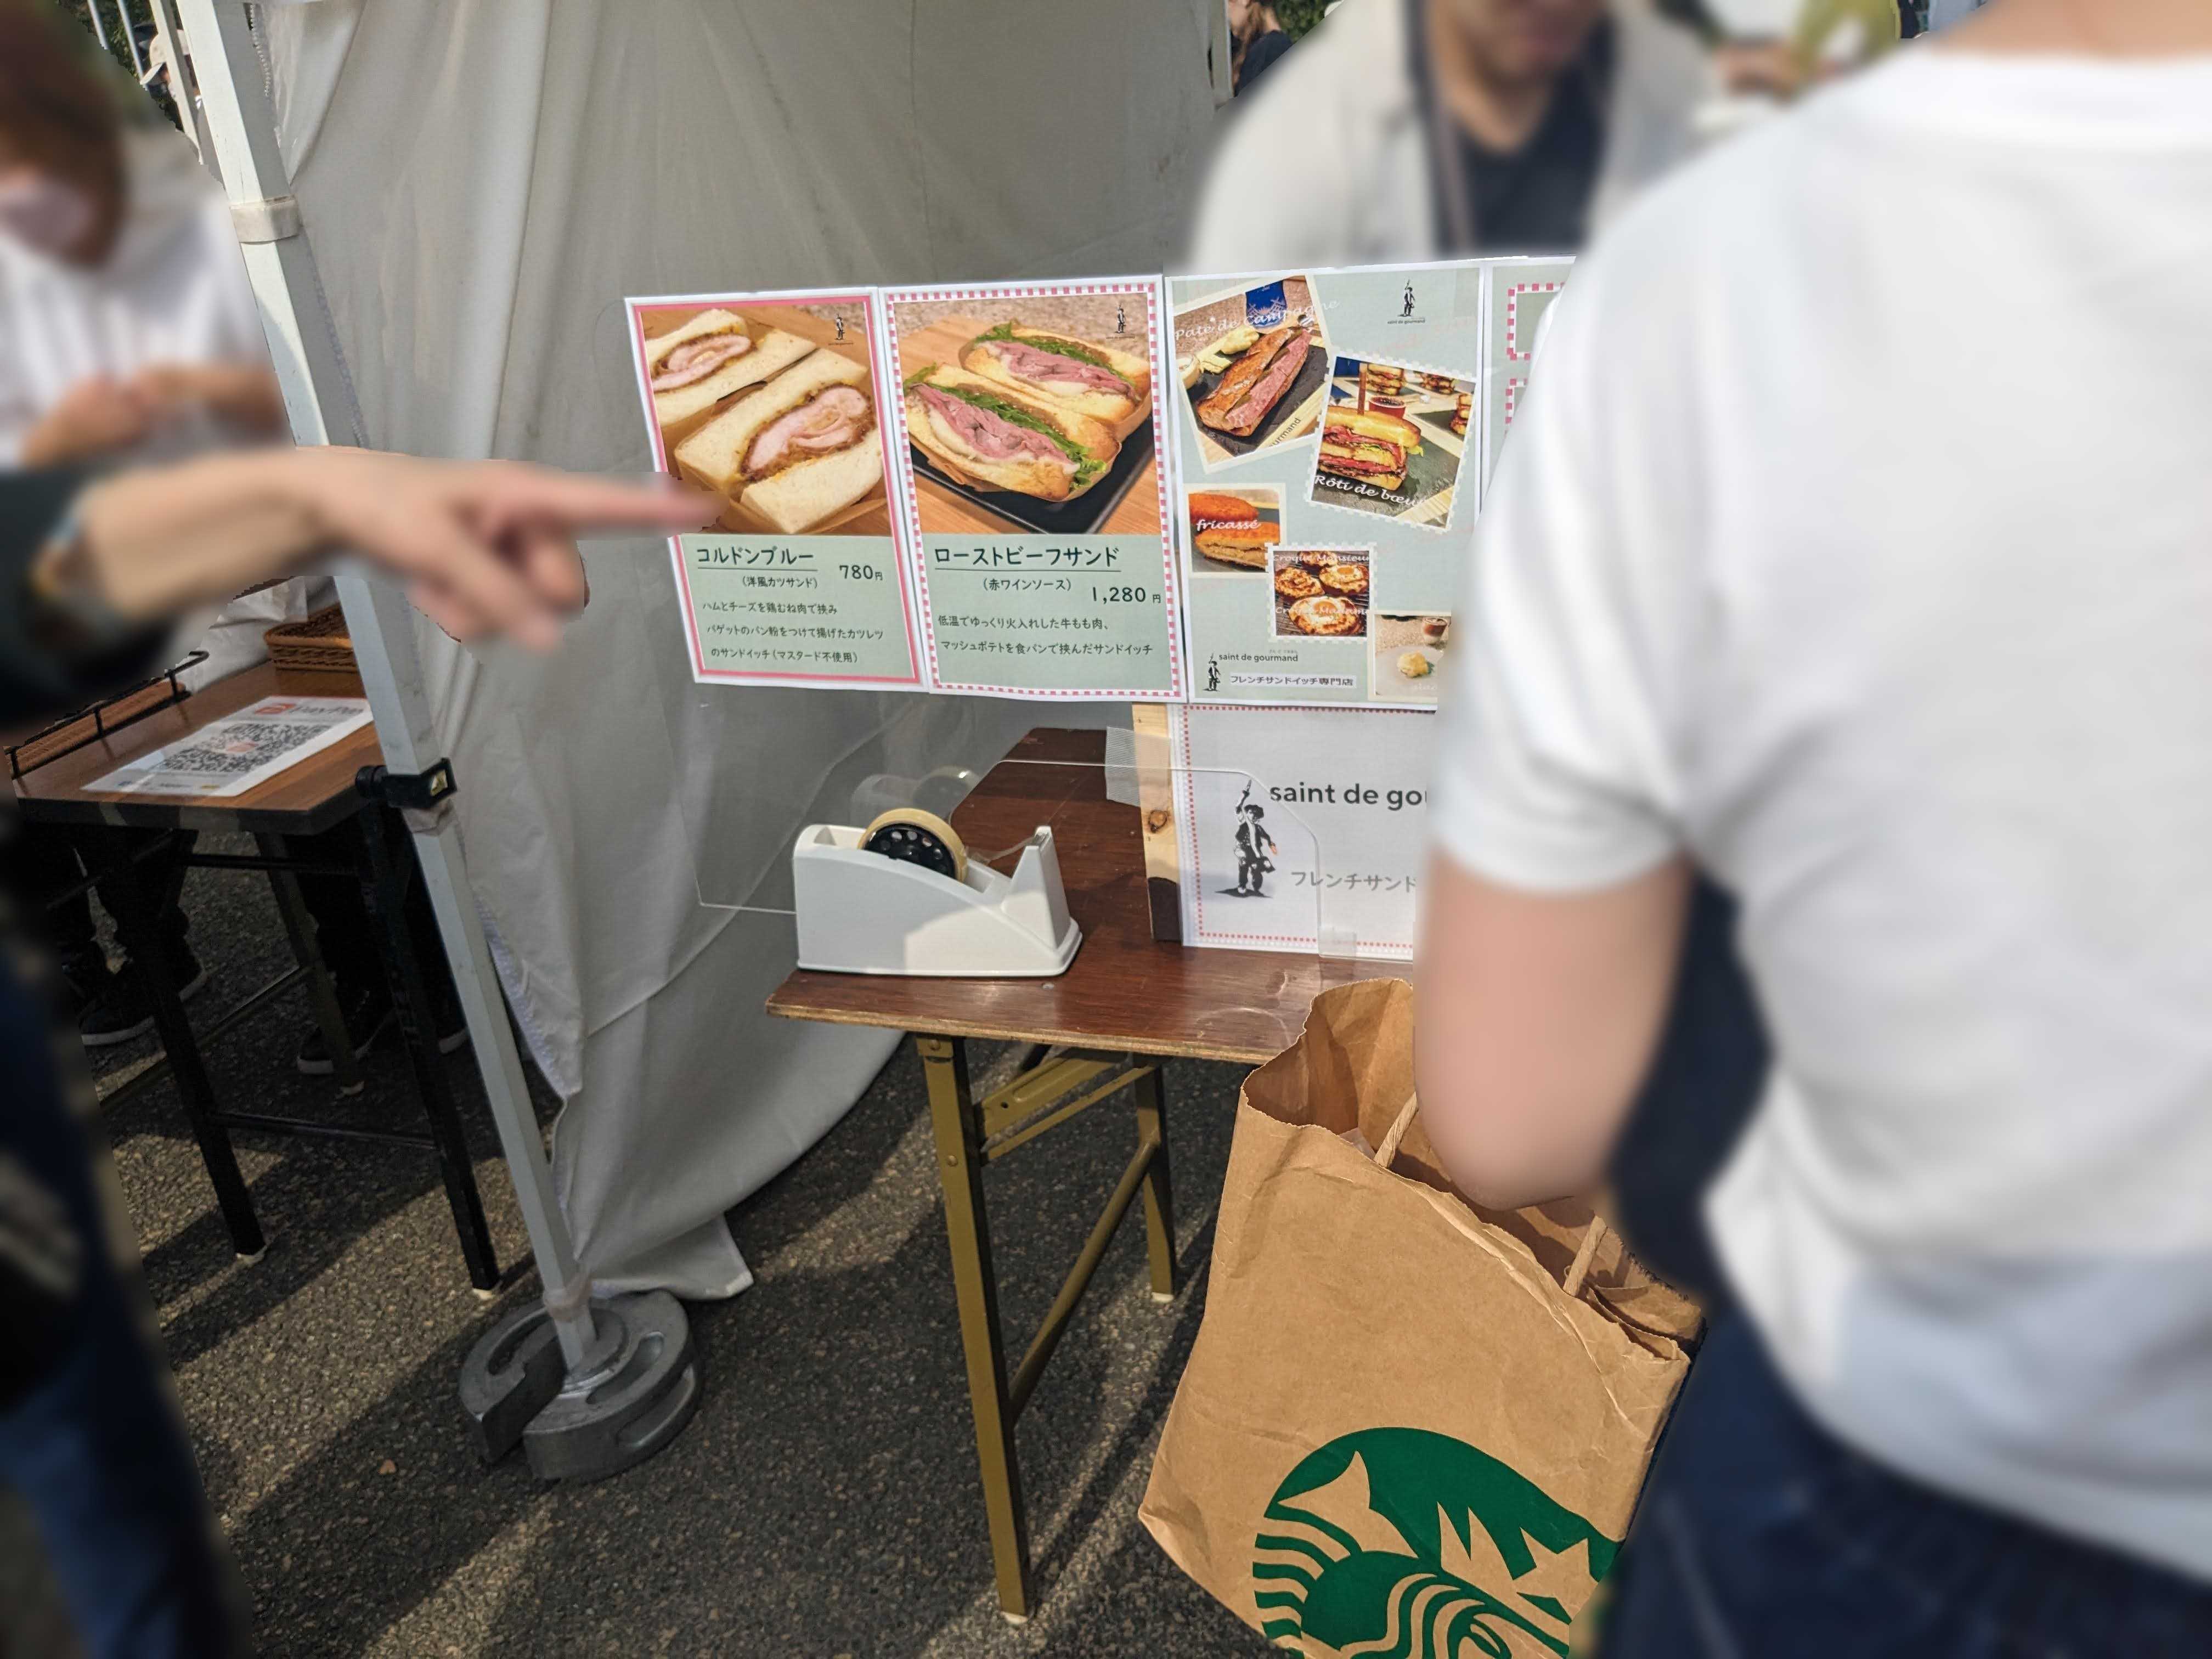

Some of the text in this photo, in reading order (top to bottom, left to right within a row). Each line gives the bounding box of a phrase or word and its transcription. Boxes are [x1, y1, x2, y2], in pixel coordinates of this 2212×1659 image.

[1268, 417, 1301, 447] urmand
[1314, 475, 1353, 490] Rôti
[1354, 483, 1379, 496] de
[1197, 519, 1261, 532] fricassé
[935, 546, 1120, 567] ローストビーフサンド
[983, 578, 1071, 592] （赤ワインソース）
[1254, 654, 1299, 663] gourmand
[1231, 675, 1354, 686] フレンチサンドイッチ専門店
[1269, 782, 1426, 811] saint de go
